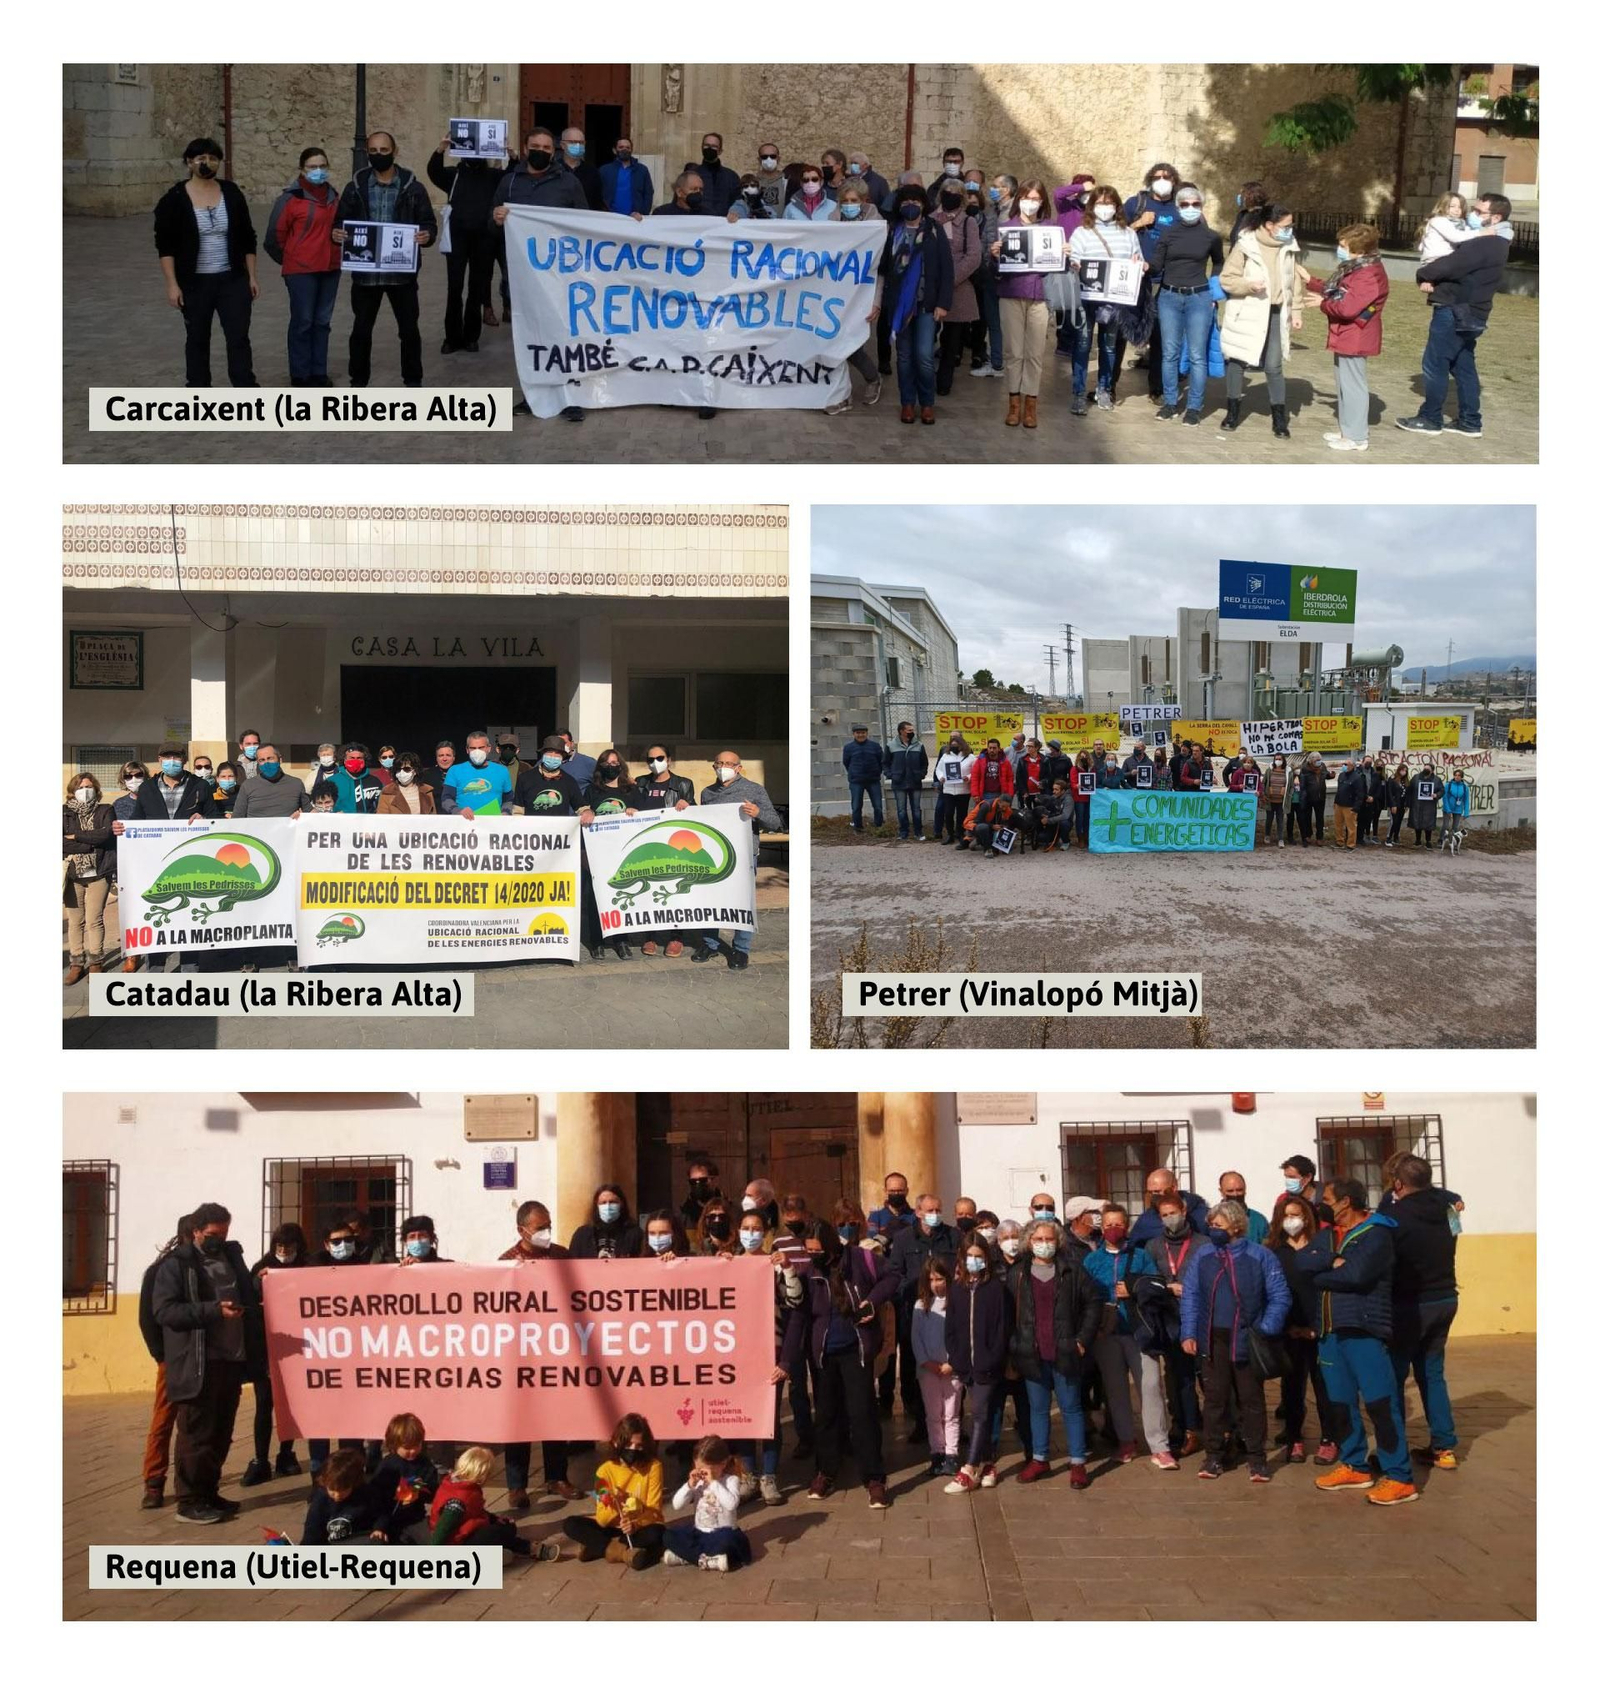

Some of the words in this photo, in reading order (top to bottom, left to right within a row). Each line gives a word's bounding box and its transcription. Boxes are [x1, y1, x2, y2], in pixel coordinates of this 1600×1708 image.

[457, 129, 469, 139] NO
[353, 235, 368, 247] NO
[1008, 239, 1021, 250] NO
[527, 236, 705, 277] UBICACIÓ
[731, 240, 875, 285] RACIONAL
[1086, 268, 1099, 279] NO
[568, 281, 845, 340] RENOVABLES
[527, 338, 619, 374] TAMBÉ
[1242, 597, 1286, 606] ELÉCTRICA
[1304, 593, 1348, 602] IBERDROLA
[1303, 609, 1337, 617] ELÉCTRICA
[1280, 630, 1298, 638] ELDA
[351, 636, 420, 657] CASA
[433, 637, 467, 657] LA
[481, 637, 545, 657] VILA
[1122, 707, 1181, 719] PETRER
[939, 715, 987, 729] STOP
[1044, 717, 1088, 730] STOP
[1304, 719, 1338, 731] STOP
[1410, 719, 1440, 730] STOP
[1248, 734, 1261, 744] NO
[1251, 744, 1264, 754] LA
[1267, 740, 1298, 754] BOLA
[1131, 794, 1255, 821] COMUNIDADES
[307, 832, 341, 848] PER
[352, 832, 388, 849] UNA
[398, 829, 479, 850] UBICACIÓ
[489, 833, 571, 851] RACIONAL
[1130, 822, 1250, 846] ENERGETICAS
[347, 853, 370, 870] DE
[381, 853, 412, 870] LES
[423, 854, 535, 872] RENOVABLES
[619, 867, 650, 879] Salvem
[652, 865, 664, 875] les
[665, 864, 710, 875] Pedrisses
[156, 882, 191, 893] Salvem
[193, 880, 208, 890] les
[209, 879, 256, 890] Pedrisses
[306, 876, 400, 904] MODIFICACIÓ
[405, 882, 432, 904] DEL
[434, 881, 489, 904] DECRET
[495, 880, 545, 906] 14/2020
[549, 880, 571, 902] JA!
[600, 909, 622, 931] NO
[624, 913, 633, 927] A
[636, 911, 650, 925] LA
[653, 907, 755, 925] MACROPLANTA
[125, 926, 153, 950] NO
[156, 930, 167, 946] A
[170, 928, 187, 945] LA
[191, 923, 293, 944] MACROPLANTA
[428, 927, 472, 937] UBICACIÓ
[475, 927, 520, 938] RACIONAL
[427, 940, 440, 948] DE
[442, 940, 460, 948] LES
[461, 939, 508, 948] ENERGIES
[509, 936, 570, 946] RENOVABLES
[300, 1292, 463, 1319] DESARROLLO
[473, 1290, 557, 1315] RURAL
[571, 1287, 736, 1312] SOSTENIBLE
[303, 1325, 352, 1359] NO
[361, 1319, 736, 1358] MACROPROYECTOS
[306, 1368, 343, 1389] DE
[356, 1366, 502, 1389] ENERGIAS
[517, 1364, 736, 1388] RENOVABLES
[708, 1408, 742, 1416] requena
[708, 1415, 752, 1424] sostenible
